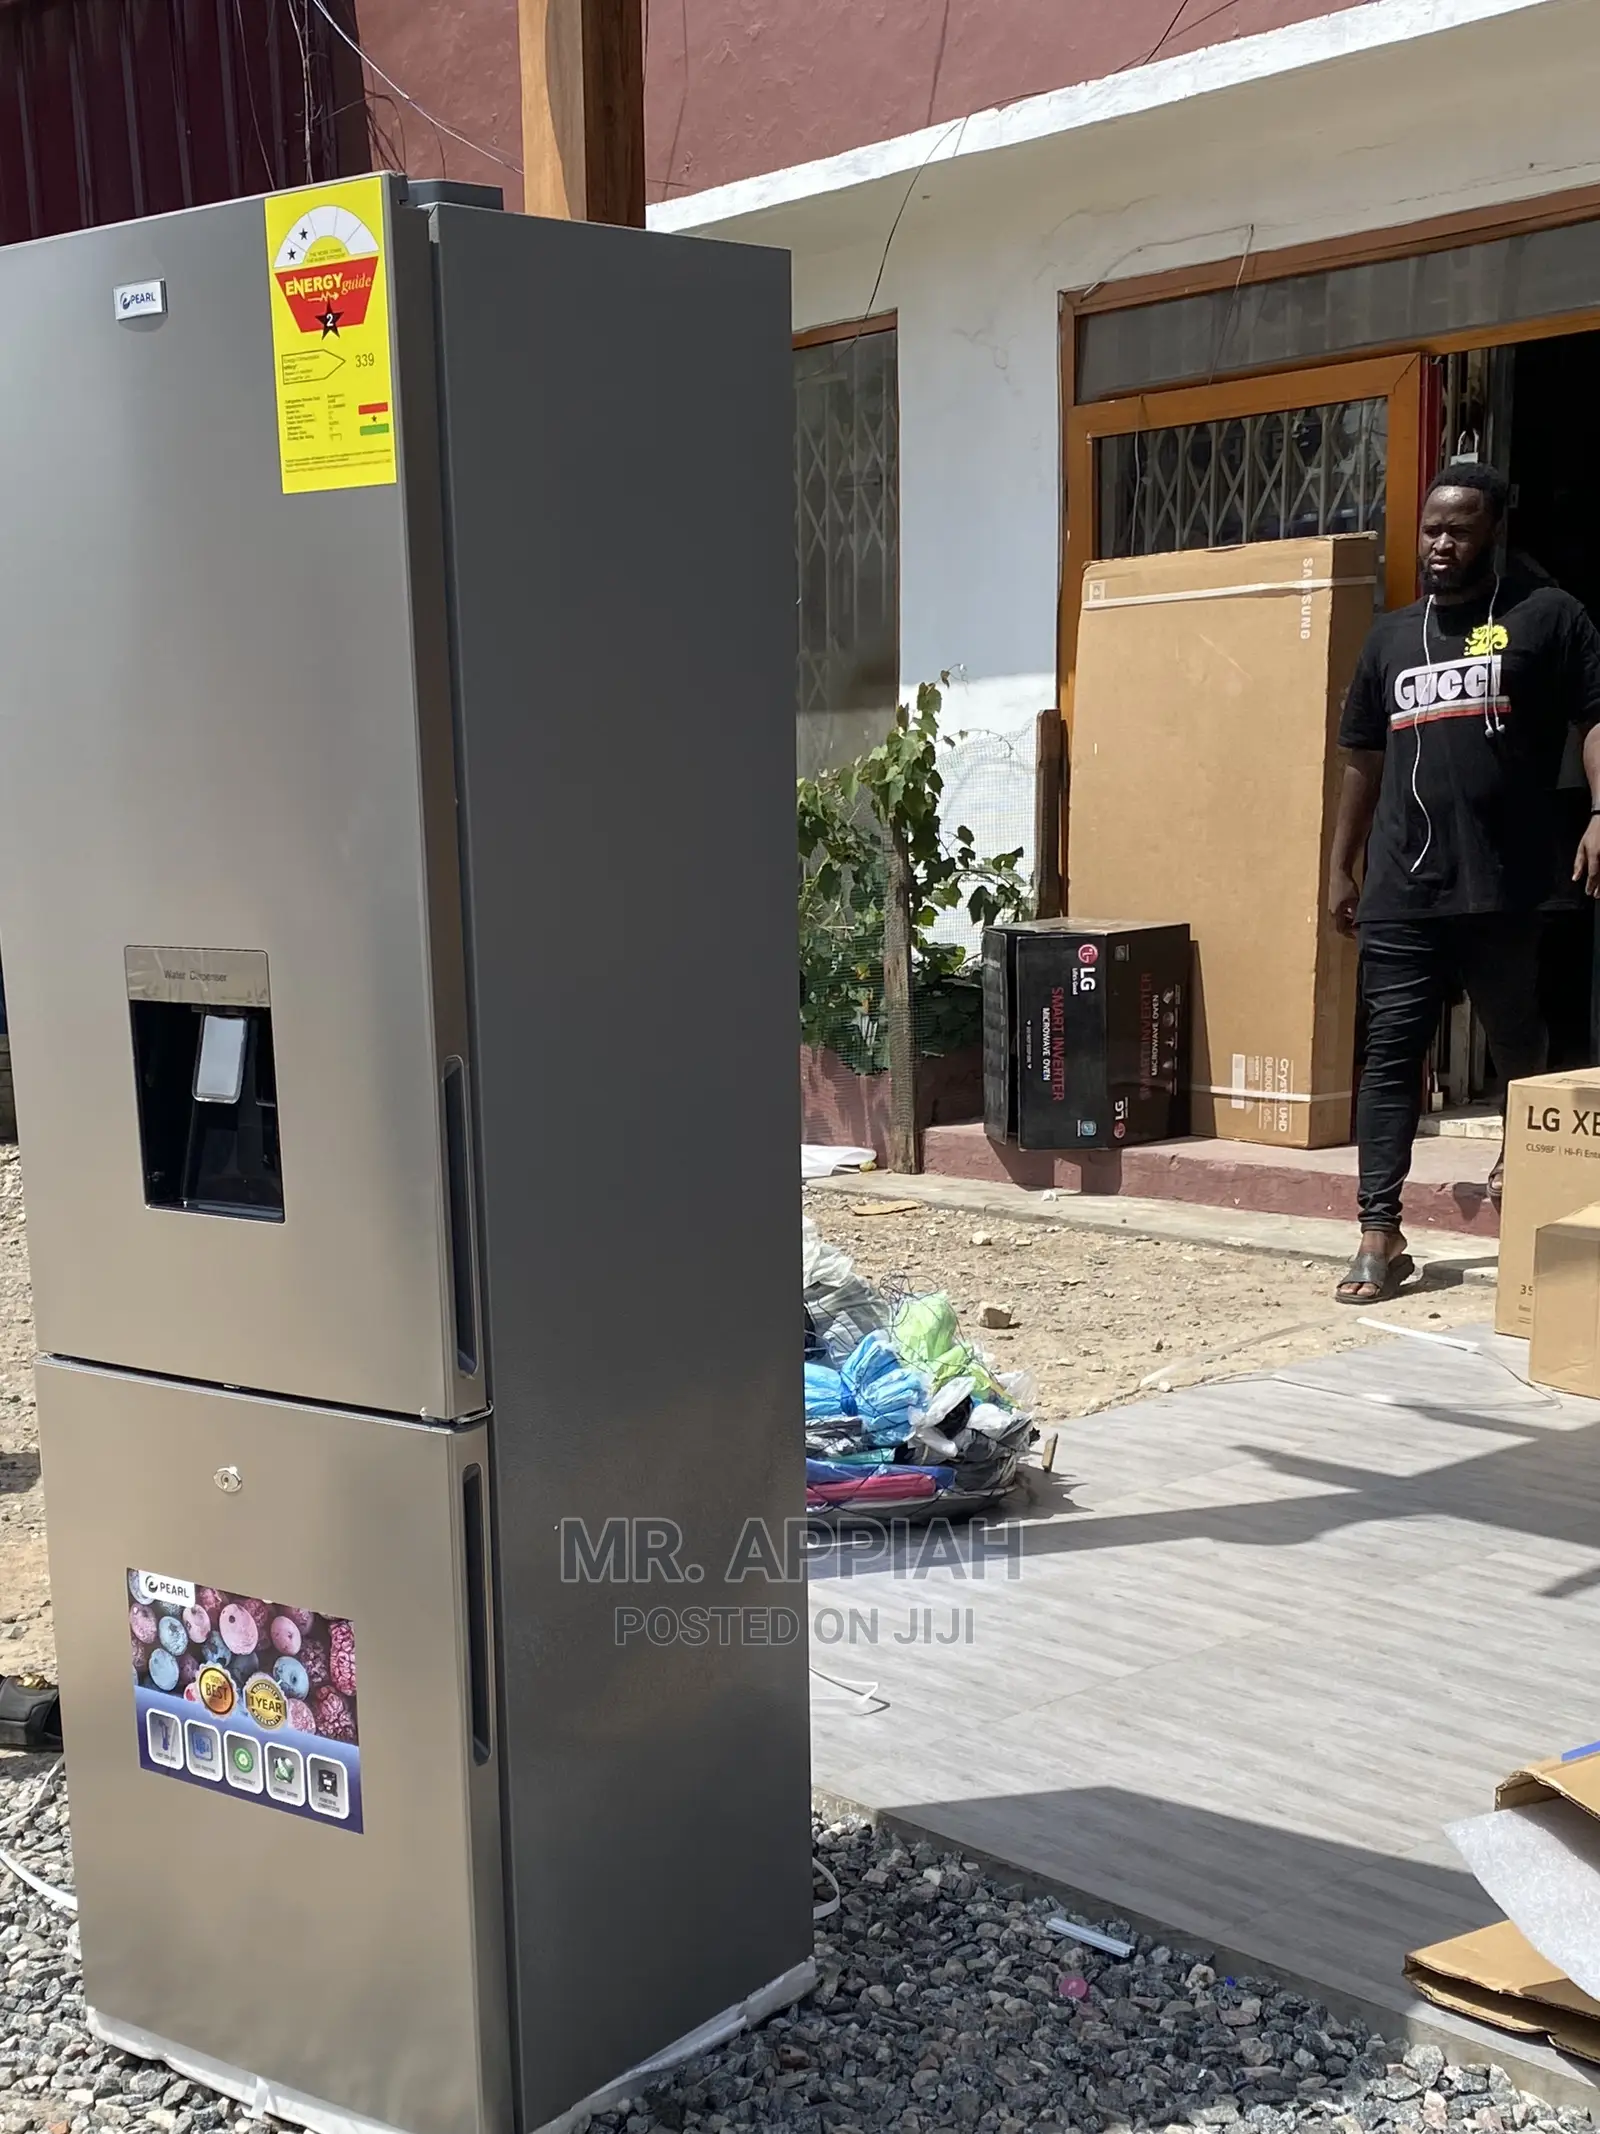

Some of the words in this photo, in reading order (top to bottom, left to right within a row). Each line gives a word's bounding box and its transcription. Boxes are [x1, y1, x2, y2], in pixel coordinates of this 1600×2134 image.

[285, 272, 343, 299] ENERGY
[341, 272, 372, 295] guide
[131, 292, 156, 304] PEARL
[326, 313, 334, 327] 2
[355, 353, 375, 367] 339
[1394, 654, 1502, 710] GUCCI
[163, 969, 186, 980] Water
[1080, 967, 1096, 991] LG
[1051, 986, 1064, 1032] SMART
[1152, 994, 1160, 1019] OVEN
[1042, 1008, 1050, 1056] MICROWAVE
[1151, 1023, 1159, 1076] MICROWAVE
[1043, 1059, 1051, 1081] OVEN
[1052, 1037, 1065, 1101] INVERTER
[1276, 1058, 1289, 1103] Cryst
[1115, 1100, 1124, 1120] LG
[1278, 1107, 1288, 1132] UHD
[1527, 1105, 1561, 1132] LG
[1564, 1147, 1583, 1157] Hi-Fi
[160, 1581, 190, 1599] PEARL
[205, 1682, 228, 1701] BEST
